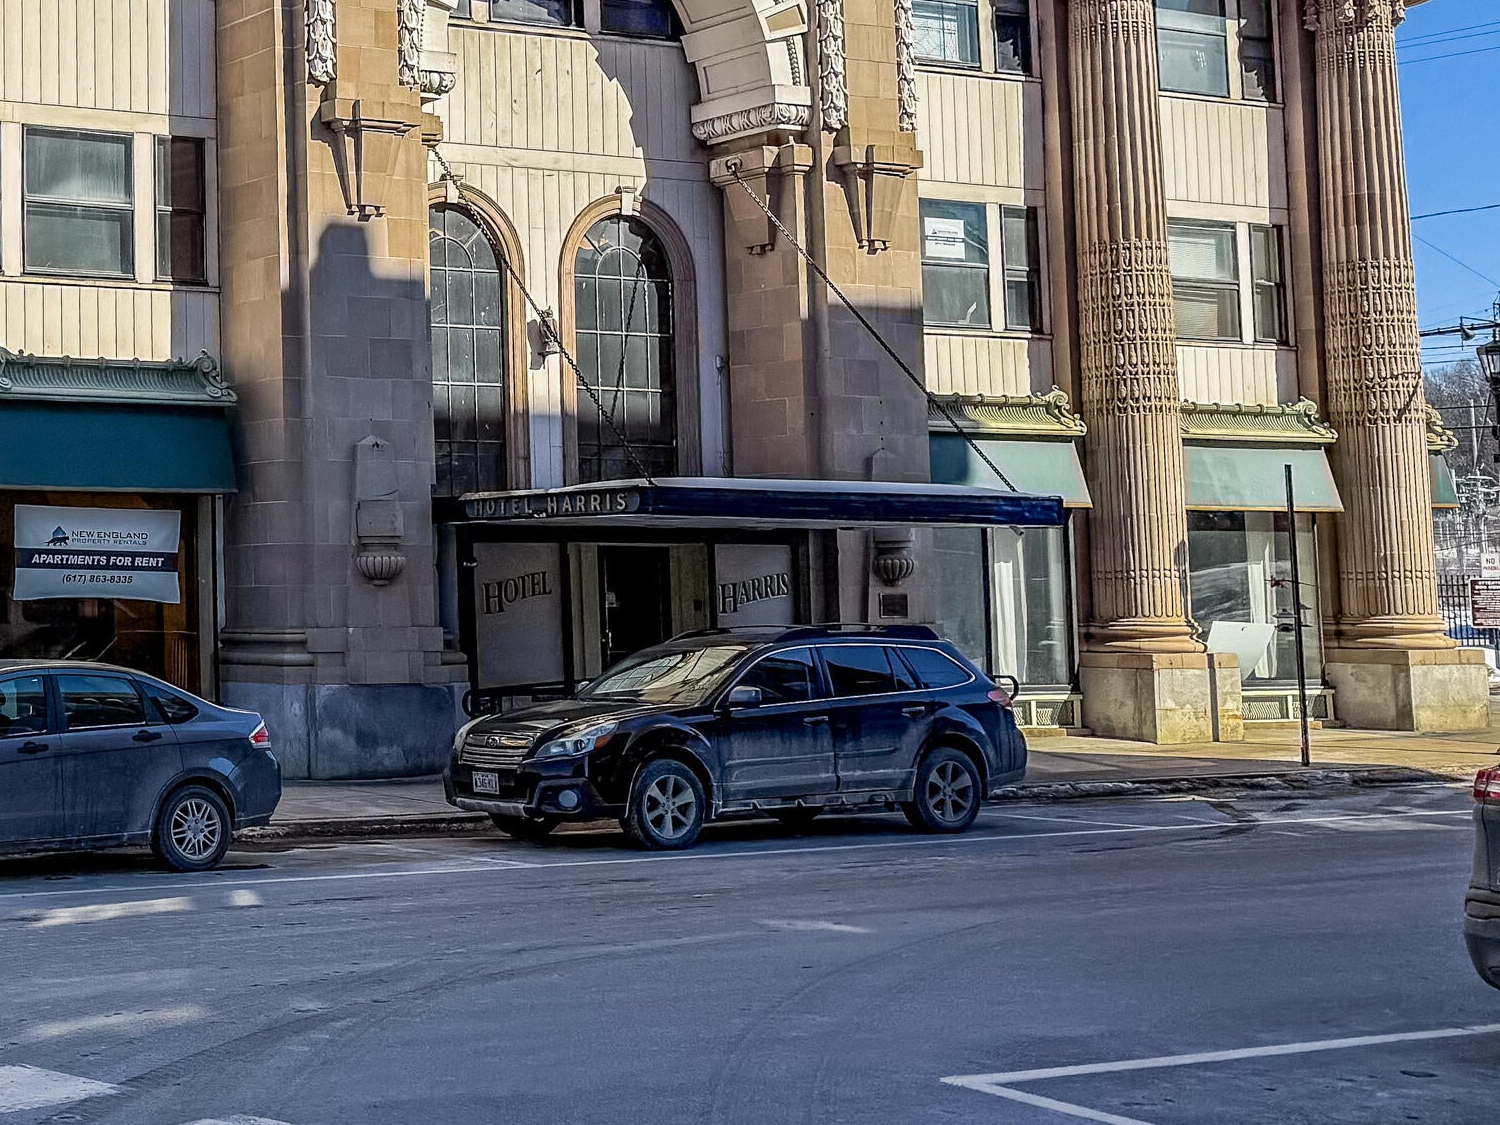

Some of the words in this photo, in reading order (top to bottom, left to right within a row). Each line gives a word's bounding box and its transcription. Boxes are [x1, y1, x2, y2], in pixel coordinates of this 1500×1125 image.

[473, 498, 533, 515] HOTEL
[547, 492, 627, 514] HARRIS
[71, 530, 95, 538] NEW
[97, 531, 148, 540] ENGLAND
[31, 554, 107, 565] APARTMENTS
[109, 556, 132, 566] FOR
[134, 557, 165, 567] RENT
[62, 574, 87, 585] (617)
[482, 571, 553, 615] HOTEL
[718, 572, 789, 615] HARRIS
